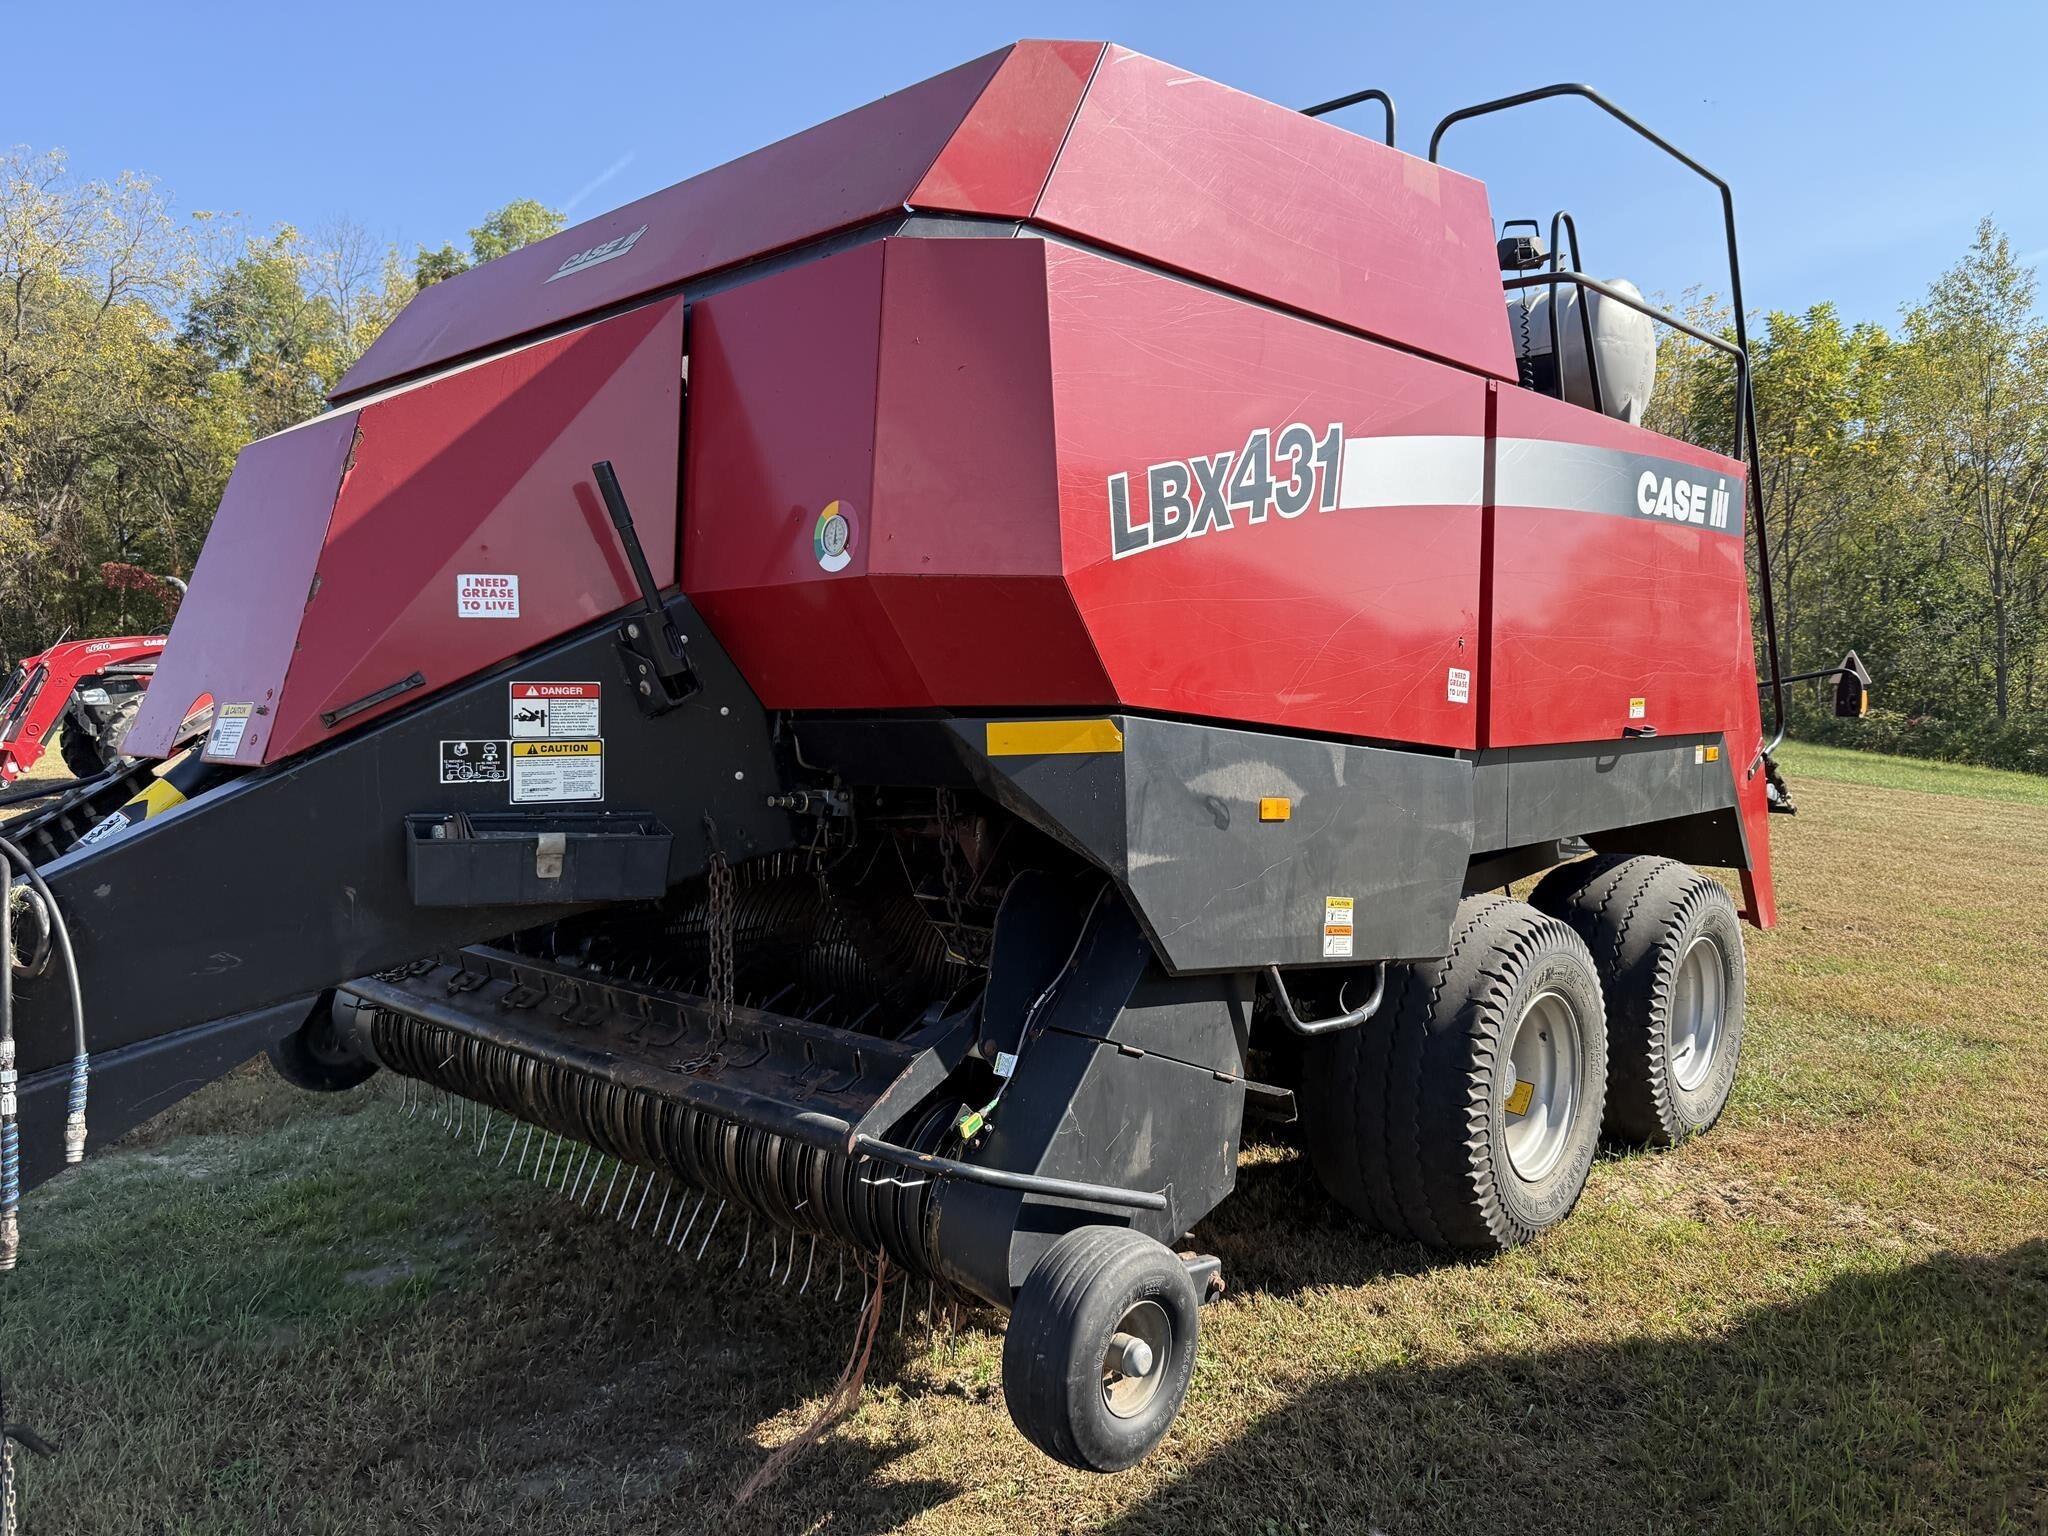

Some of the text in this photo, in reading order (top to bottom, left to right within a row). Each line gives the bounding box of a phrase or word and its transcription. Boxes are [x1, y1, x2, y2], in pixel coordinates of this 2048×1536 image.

[1107, 422, 1343, 561] LBX431
[1637, 470, 1708, 525] CASE
[466, 577, 509, 587] I NEED
[462, 588, 514, 598] GREASE
[462, 600, 515, 611] TO LIVE
[1450, 679, 1467, 688] GREASE
[541, 686, 584, 695] DANGER
[540, 744, 589, 753] CAUTION
